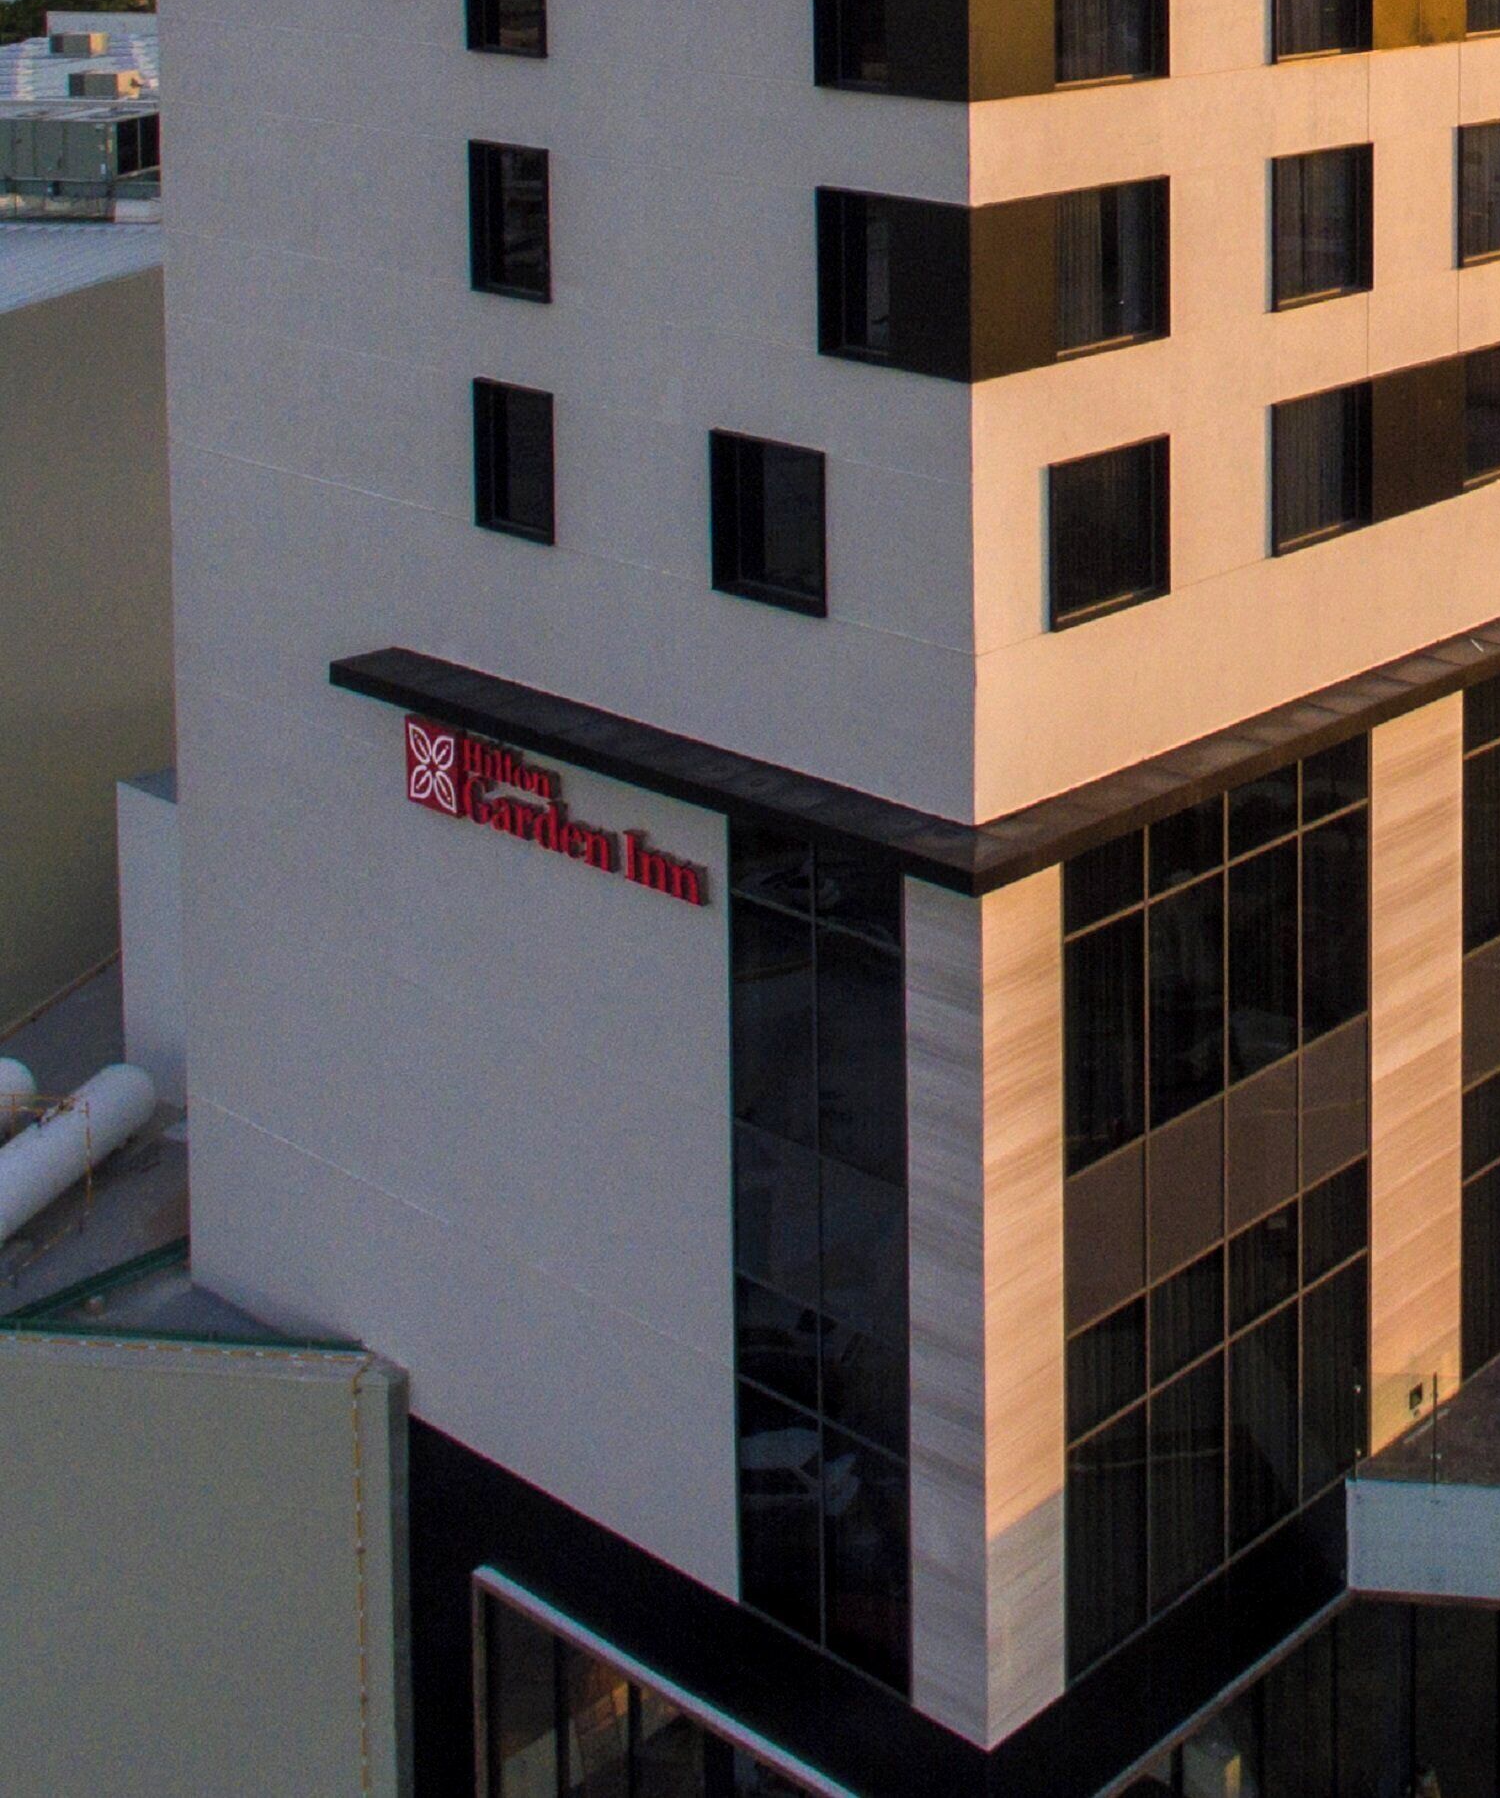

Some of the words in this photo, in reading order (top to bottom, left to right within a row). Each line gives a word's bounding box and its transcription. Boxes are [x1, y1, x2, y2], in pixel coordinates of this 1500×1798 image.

[463, 738, 556, 799] Hilton
[463, 776, 613, 873] Garden
[624, 829, 705, 907] Inn
